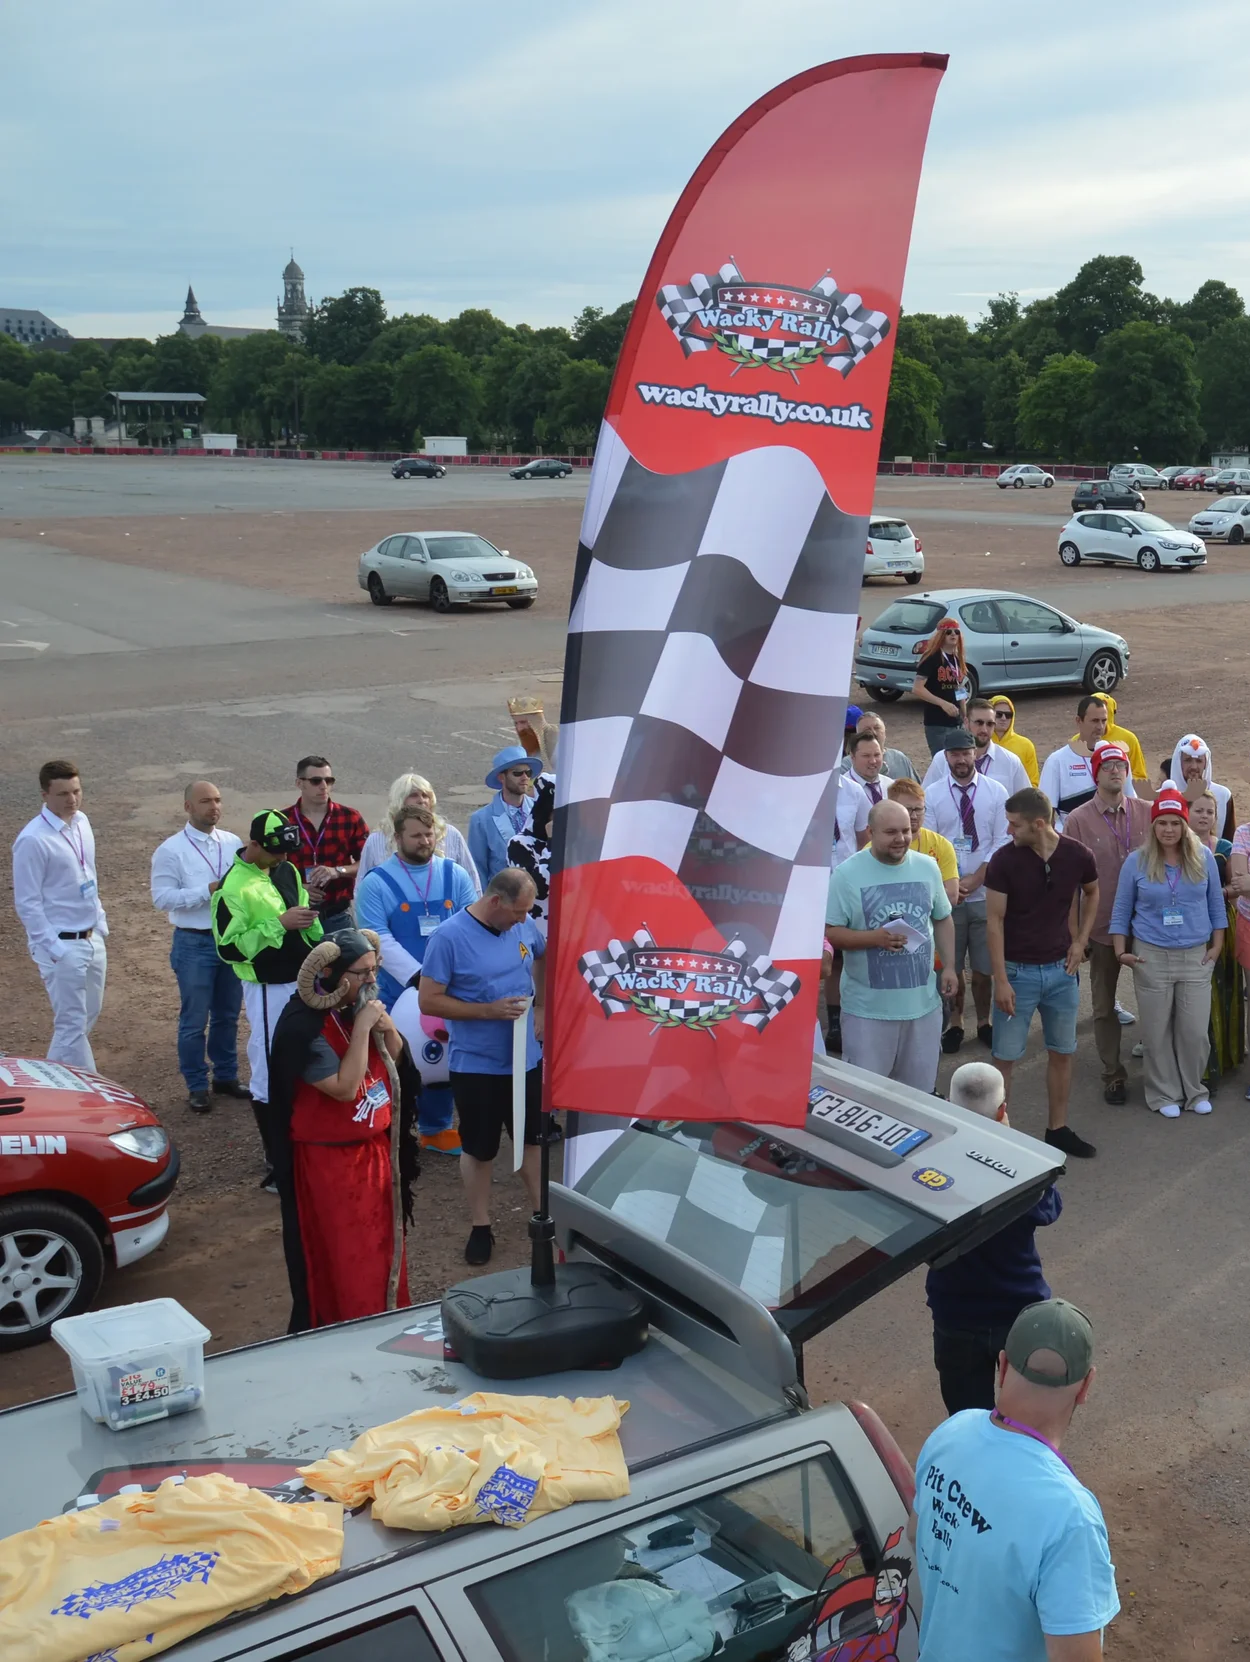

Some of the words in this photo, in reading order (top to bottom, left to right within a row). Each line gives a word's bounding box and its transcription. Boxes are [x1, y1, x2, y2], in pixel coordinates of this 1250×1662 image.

[696, 308, 778, 332] Wacky
[780, 313, 845, 346] Rally
[637, 384, 871, 429] wackyrally.co.uk
[613, 972, 692, 994] Wacky
[694, 975, 758, 1005] Rally
[0, 1135, 67, 1155] ELIN
[918, 1169, 948, 1188] GB
[121, 1379, 142, 1388] VALUE
[924, 1465, 945, 1493] Pit
[947, 1480, 993, 1535] Crew
